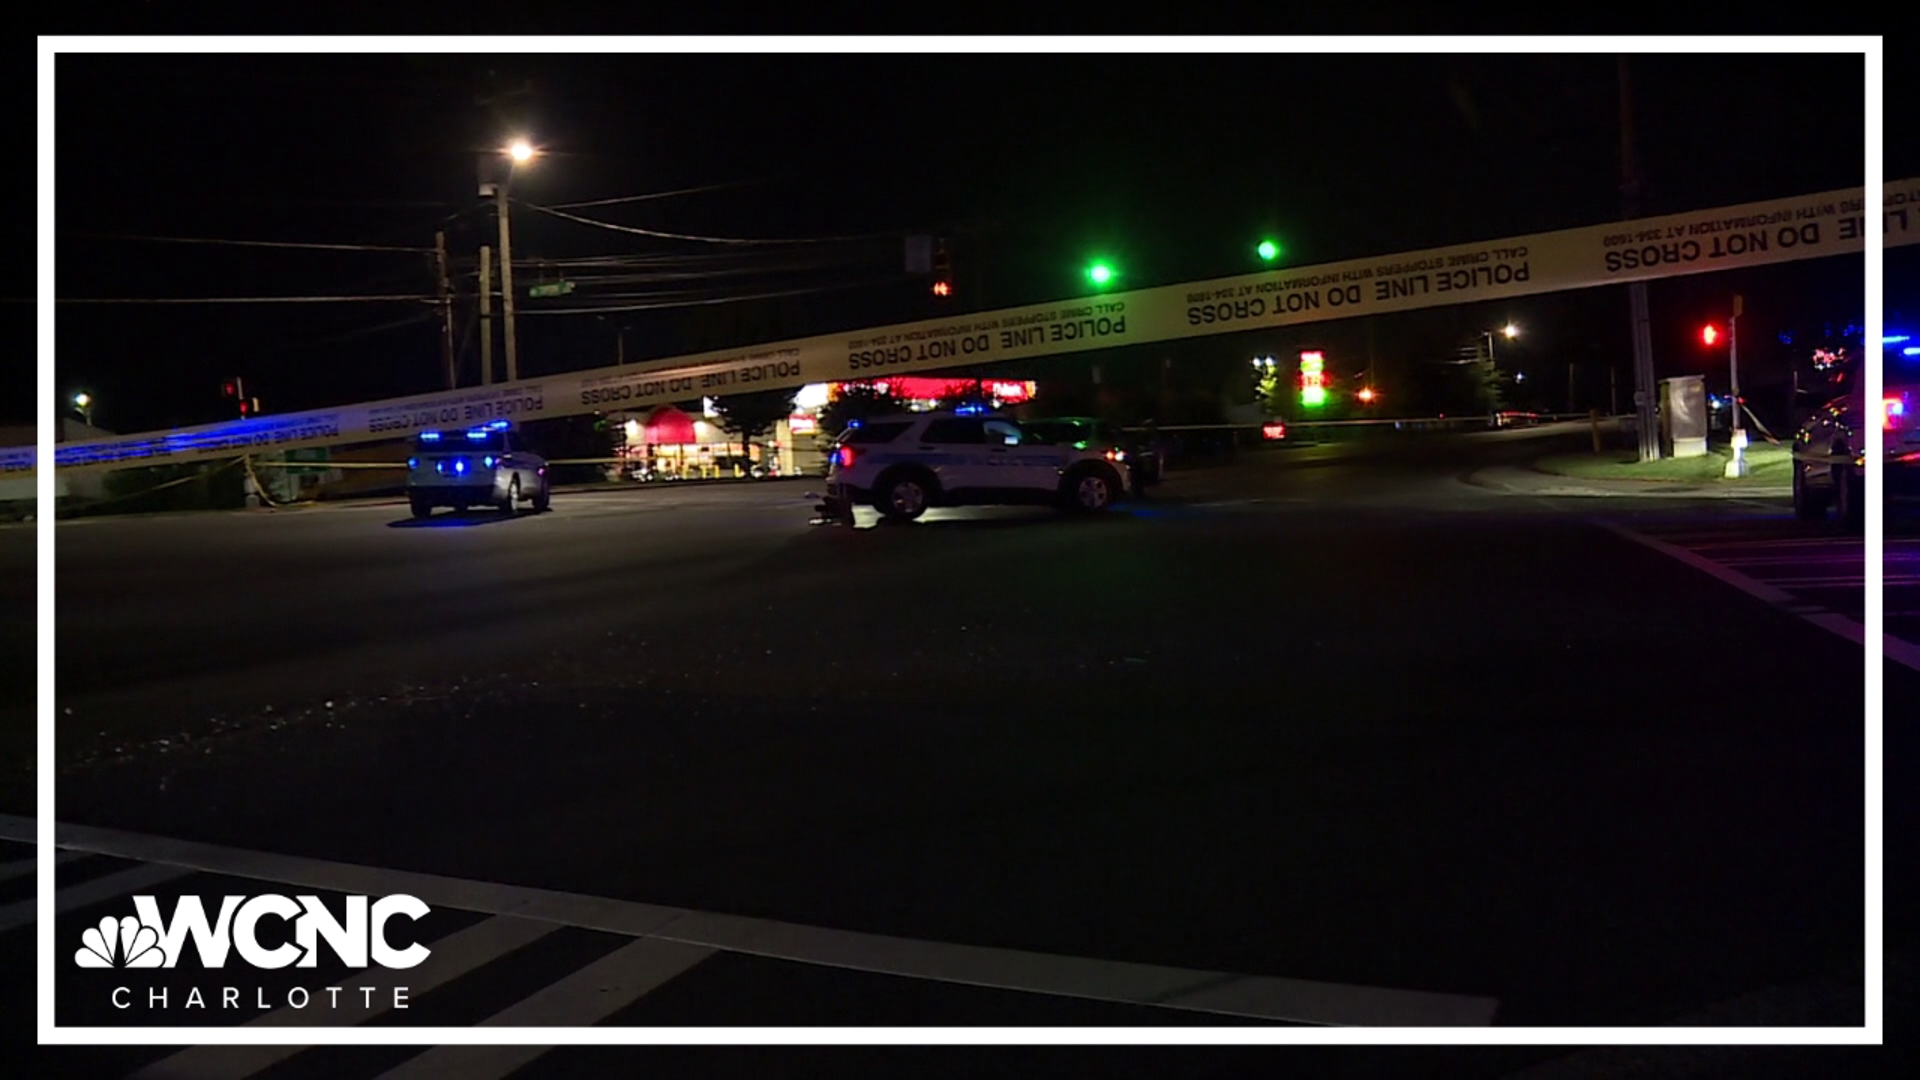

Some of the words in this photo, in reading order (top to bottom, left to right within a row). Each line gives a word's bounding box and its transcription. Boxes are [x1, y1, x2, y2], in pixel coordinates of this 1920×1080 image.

[1666, 224, 1686, 239] AT
[1777, 223, 1819, 248] DO
[1839, 210, 1908, 240] LIE
[1492, 246, 1528, 261] CALL
[1708, 229, 1768, 258] NOT
[1448, 250, 1489, 267] CRIME
[1605, 240, 1700, 272] CROSS
[1343, 268, 1374, 281] WITH
[1376, 257, 1445, 278] STOPPERS
[1437, 261, 1530, 292] POLICE
[1238, 285, 1253, 297] AT
[1327, 285, 1361, 307] DO
[1375, 274, 1429, 301] LINE
[1095, 302, 1125, 315] CALL
[1187, 299, 1266, 326] CROSS
[1272, 291, 1320, 315] NOT
[1000, 326, 1045, 349] LINE
[1051, 315, 1127, 342] POLICE
[916, 341, 956, 362] NOT
[962, 334, 990, 355] DO
[848, 346, 912, 370] CROSS
[701, 370, 736, 388] LINE
[741, 360, 800, 383] POLICE
[581, 384, 631, 405] CROSS
[635, 381, 665, 397] NOT
[670, 377, 692, 393] DO
